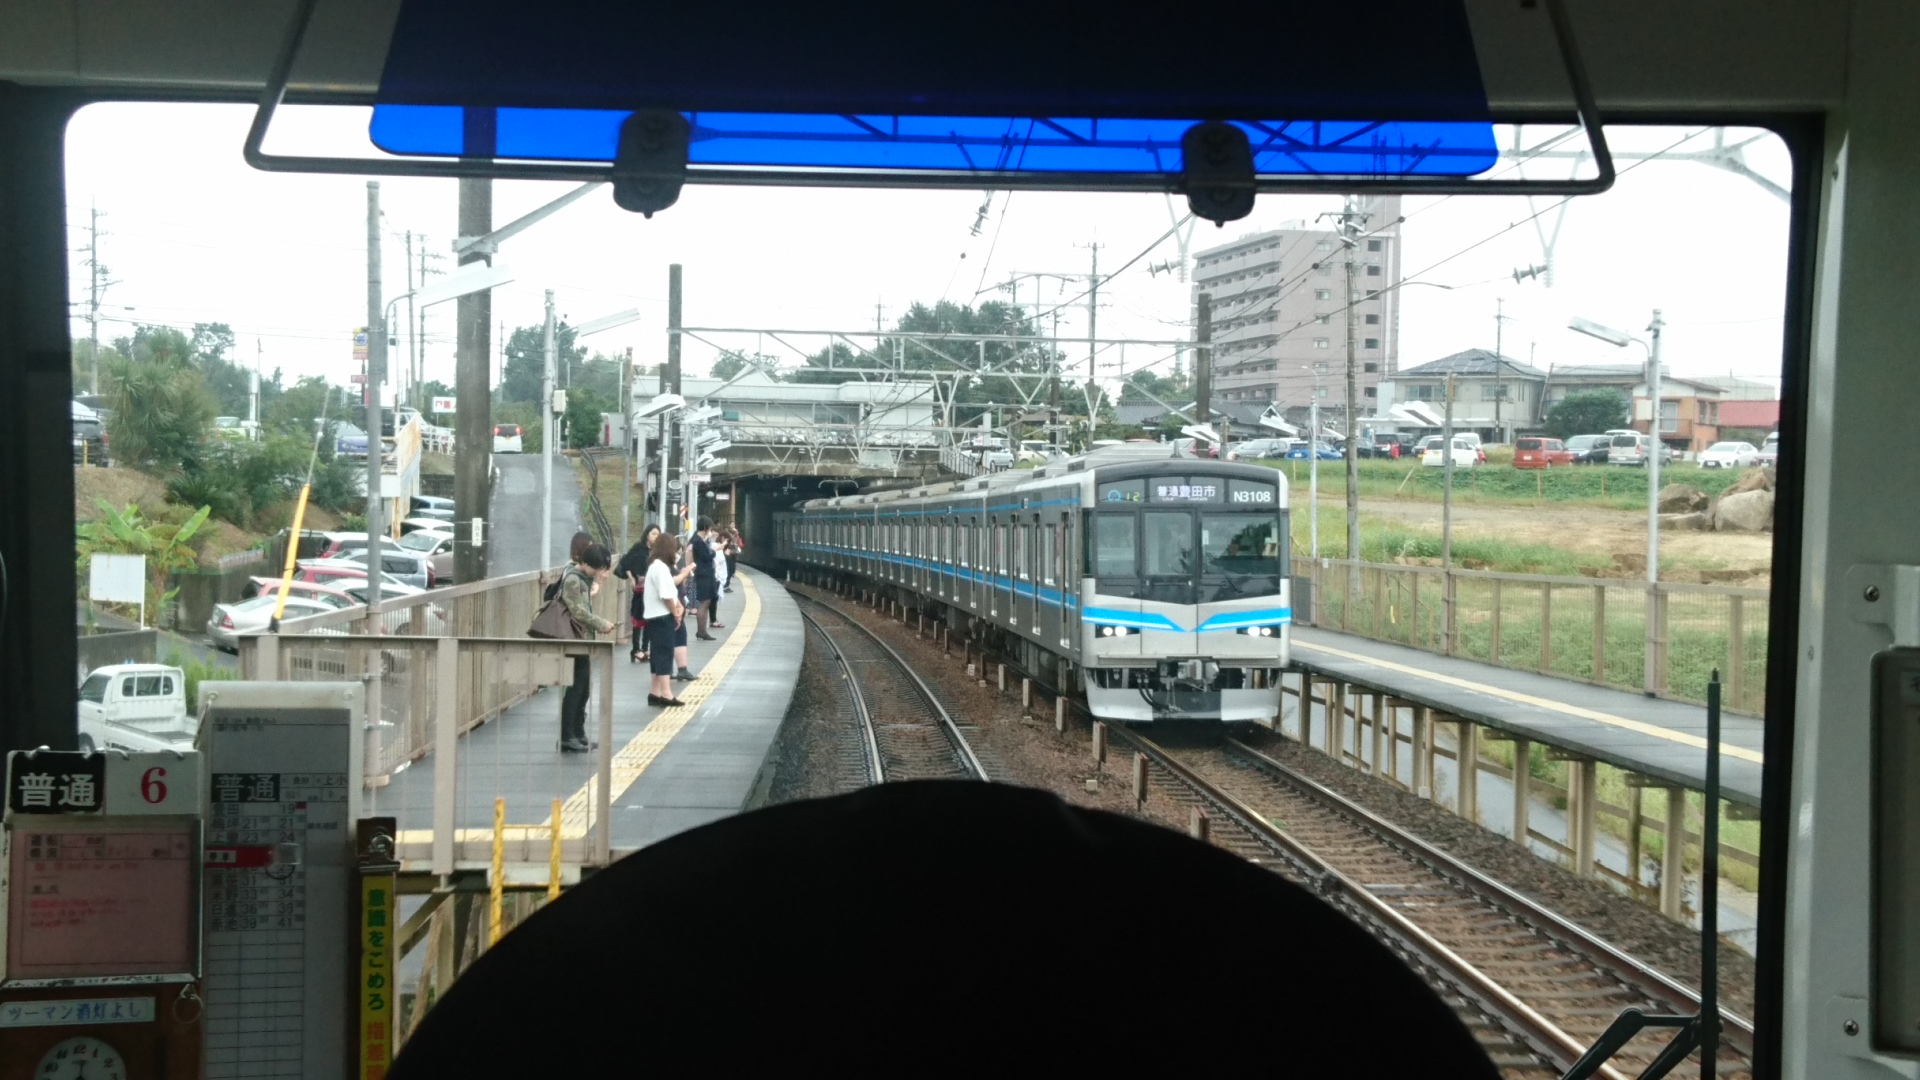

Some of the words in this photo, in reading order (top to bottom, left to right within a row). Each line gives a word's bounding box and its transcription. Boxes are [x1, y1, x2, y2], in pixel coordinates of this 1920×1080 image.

[1233, 491, 1271, 503] N3108
[18, 772, 95, 807] 普通
[140, 767, 168, 804] 6
[215, 774, 276, 801] 普通
[242, 818, 258, 829] 21
[279, 818, 294, 828] 21
[243, 832, 259, 843] 23
[279, 831, 295, 843] 24
